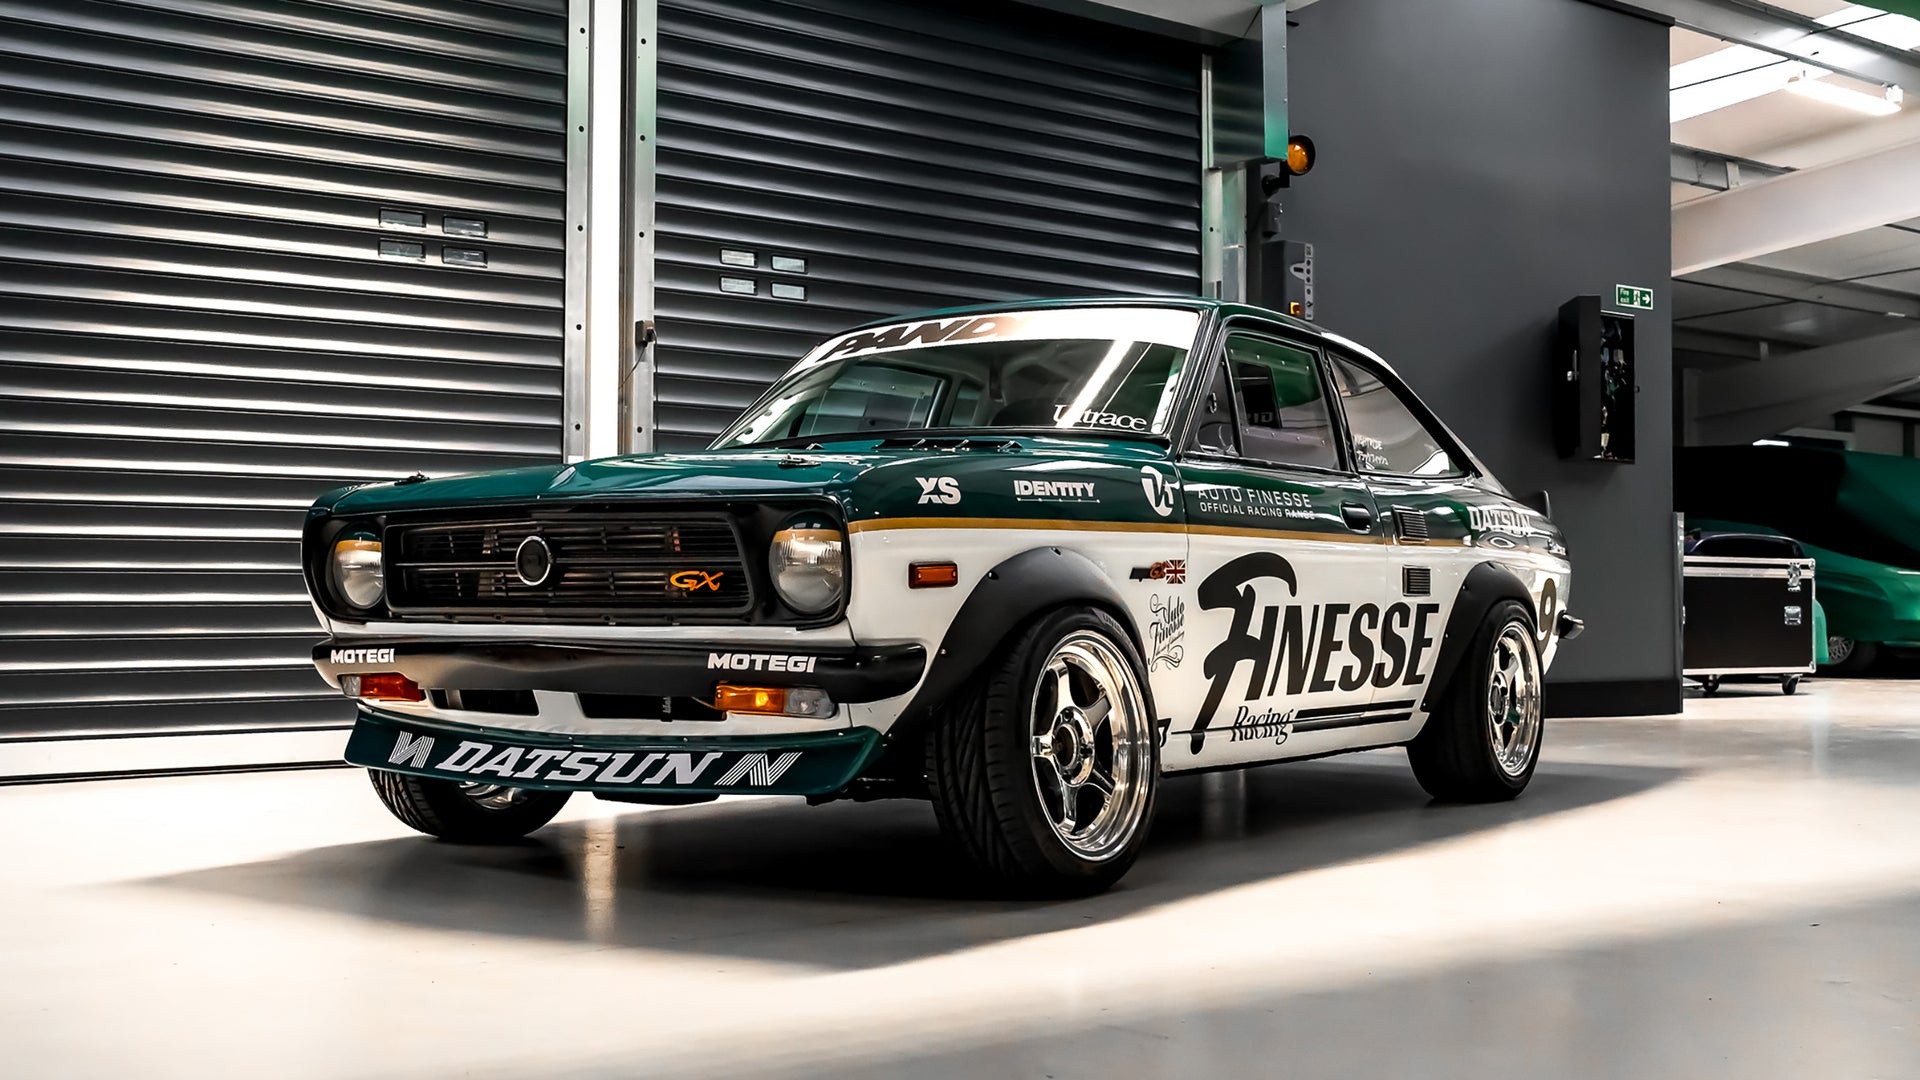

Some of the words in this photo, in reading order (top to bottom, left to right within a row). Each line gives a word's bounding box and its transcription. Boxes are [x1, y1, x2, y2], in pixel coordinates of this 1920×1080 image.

[1053, 403, 1147, 431] Utrace
[915, 476, 962, 505] XS
[1013, 479, 1096, 498] IDENTITY
[1198, 487, 1243, 502] AUTO
[1246, 488, 1312, 508] FINESSE
[1200, 501, 1245, 515] OFFICIAL
[1247, 505, 1283, 518] RACING
[1466, 506, 1532, 535] DATSUN
[669, 570, 724, 591] GX
[330, 647, 395, 665] MOTEGI
[707, 652, 817, 674] MOTEGI
[1230, 705, 1295, 746] Racing
[434, 740, 723, 786] DATSUN
